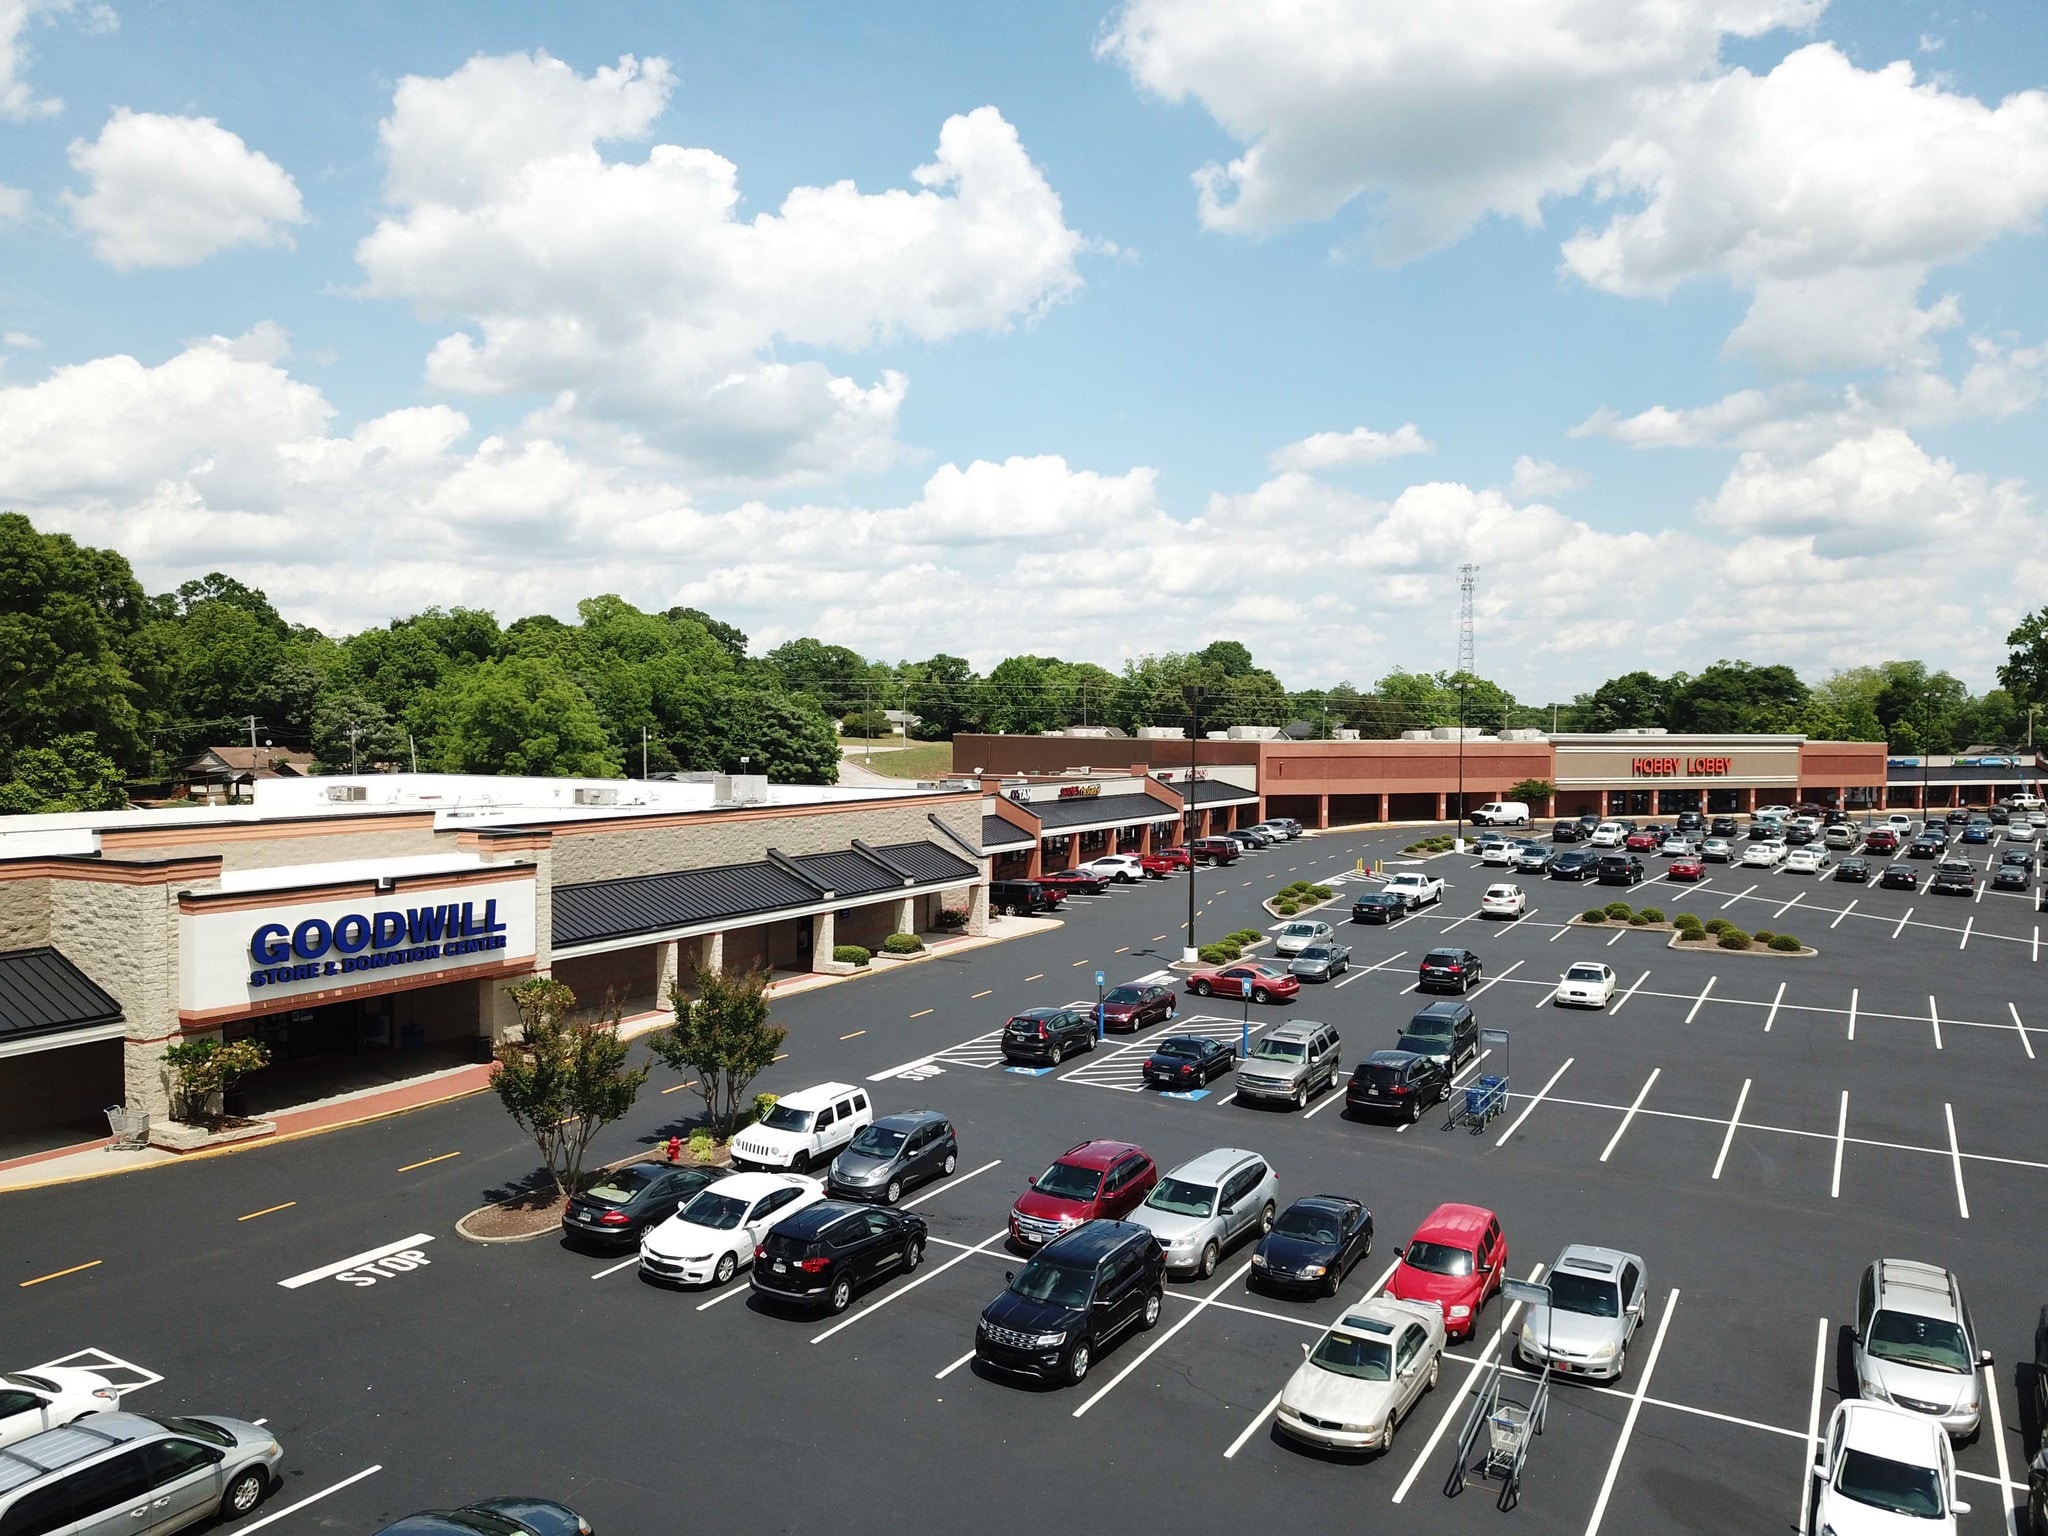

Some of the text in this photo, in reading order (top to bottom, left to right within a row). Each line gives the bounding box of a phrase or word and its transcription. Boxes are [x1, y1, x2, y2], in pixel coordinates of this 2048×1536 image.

[1633, 758, 1732, 774] HOBBY LOBBY
[250, 899, 507, 966] GOODWILL
[251, 935, 507, 988] STORE & DONATION CENTER
[335, 1249, 432, 1287] STOP
